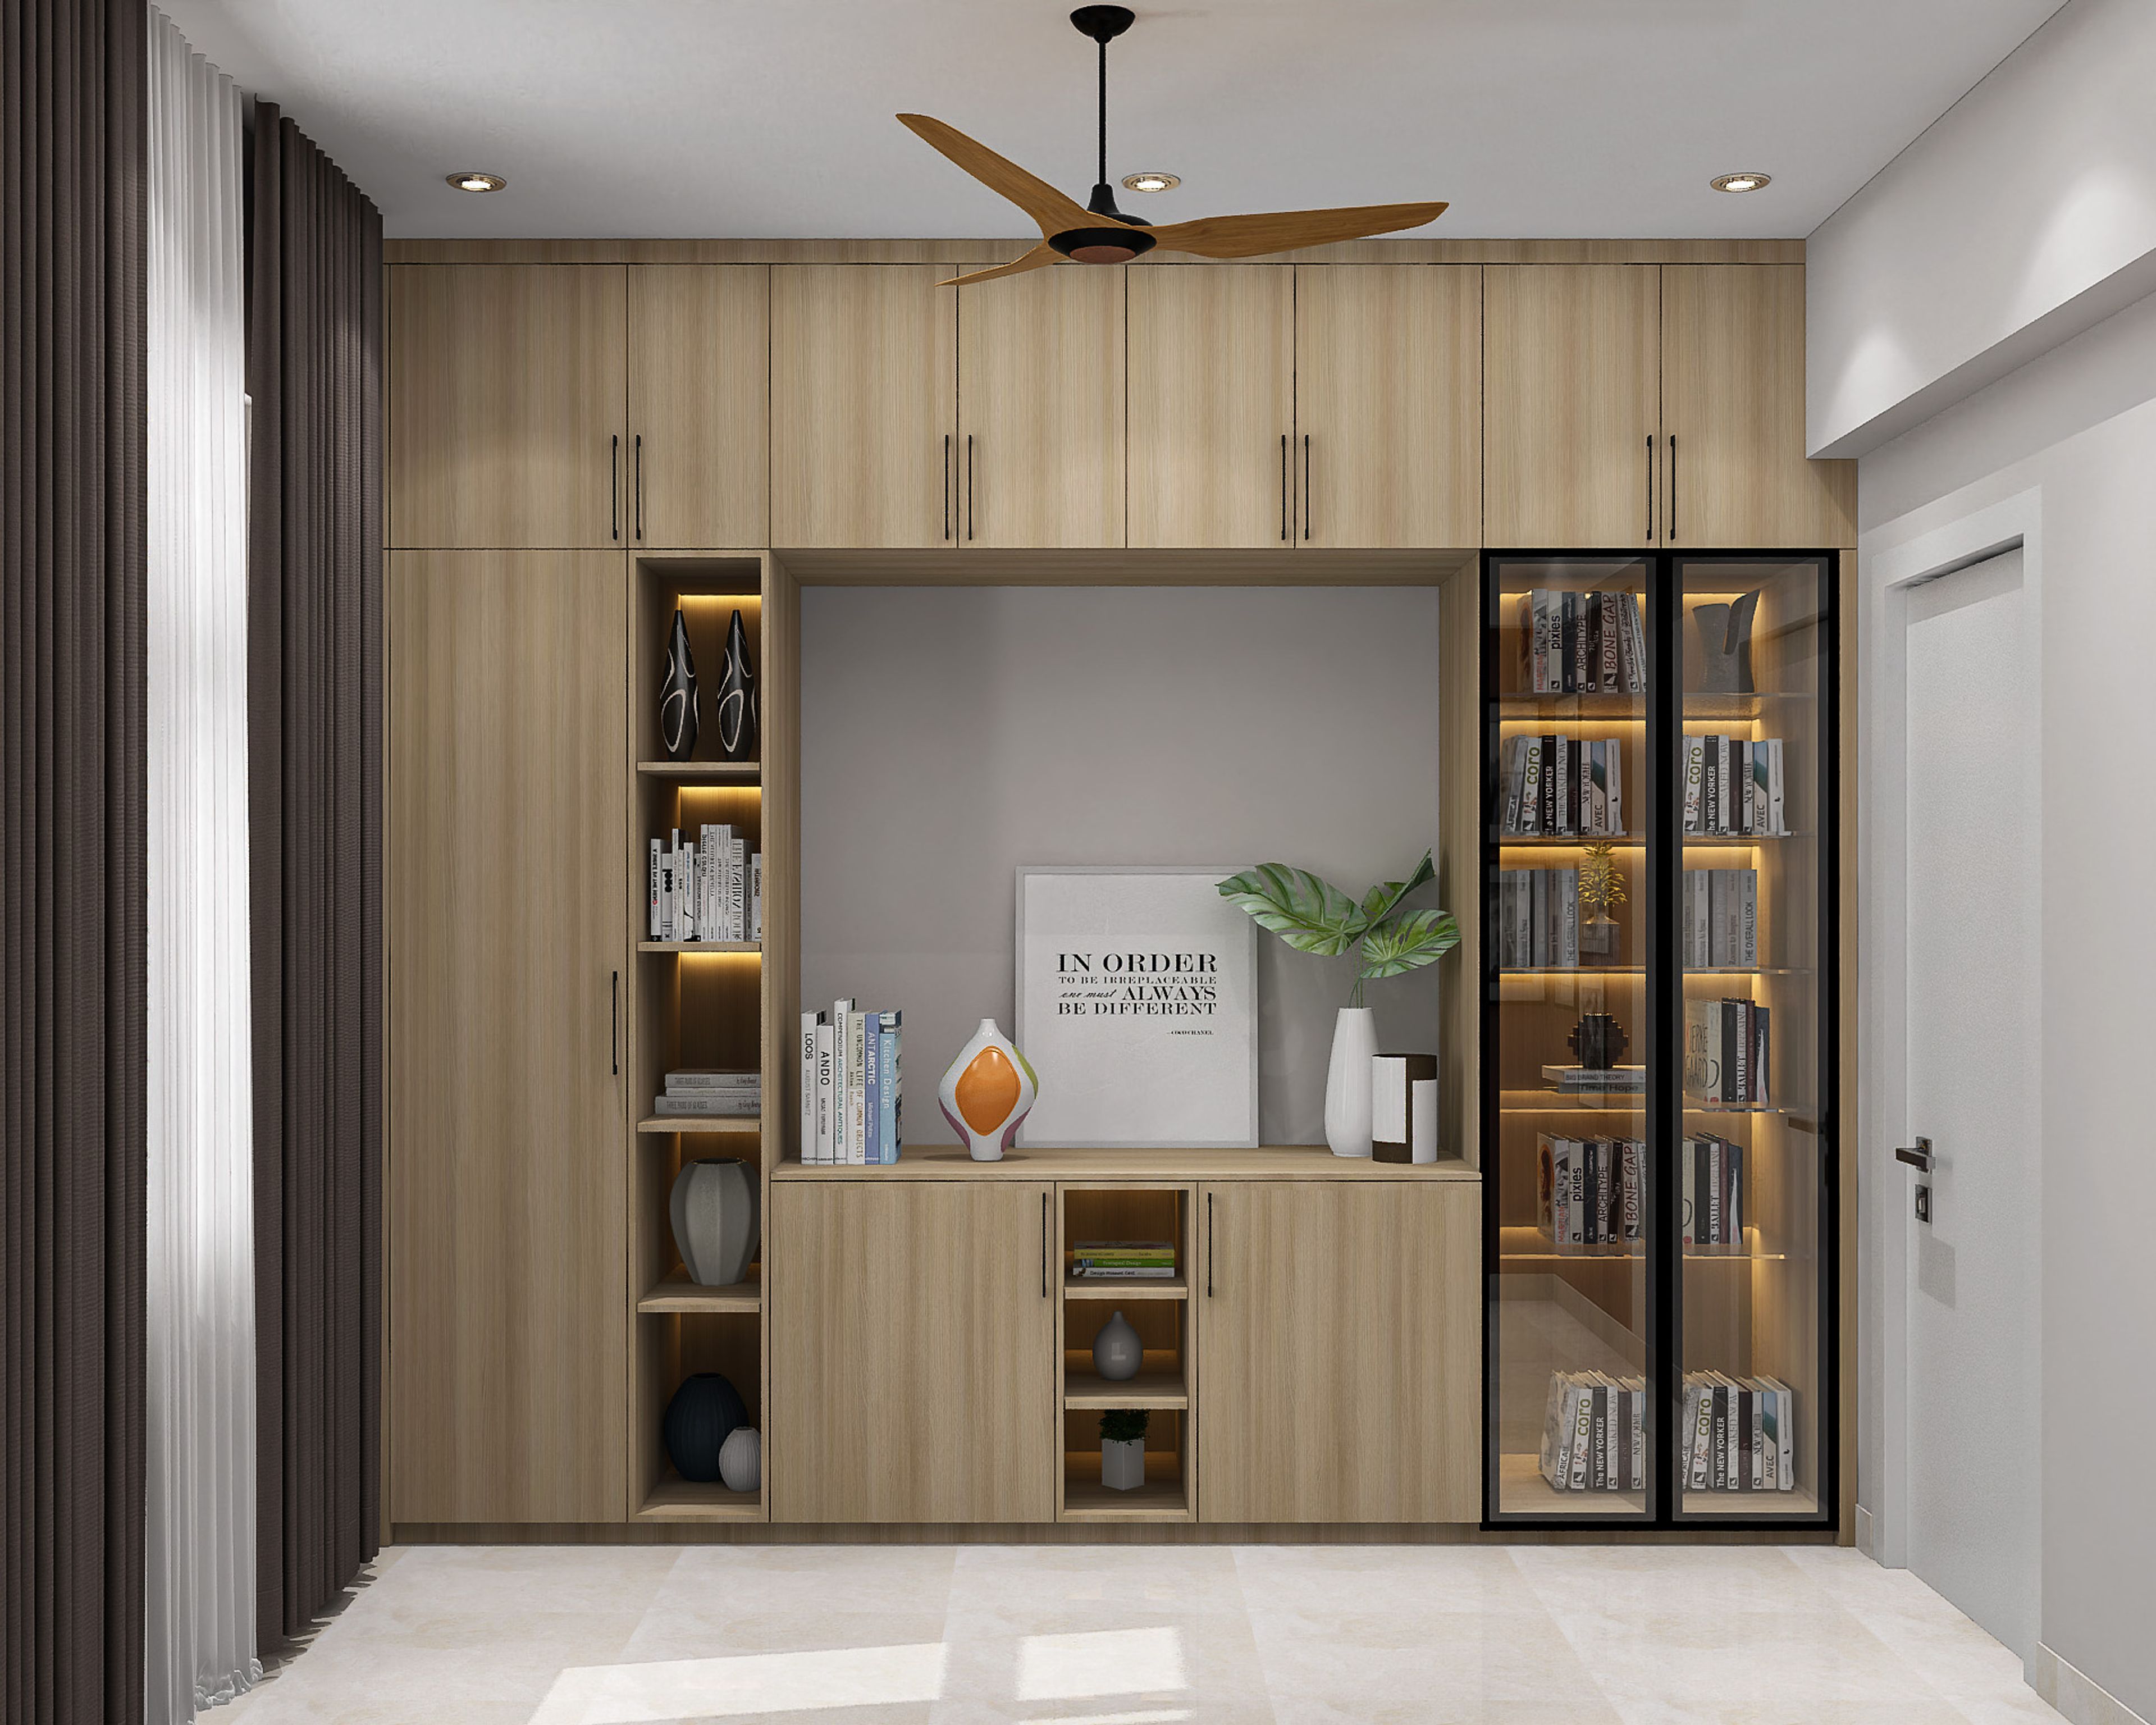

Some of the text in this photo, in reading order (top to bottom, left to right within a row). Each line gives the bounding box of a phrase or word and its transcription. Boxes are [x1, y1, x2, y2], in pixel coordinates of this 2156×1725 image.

[1549, 615, 1563, 650] pixies
[1577, 615, 1586, 671] ARCHITYPE
[1602, 594, 1617, 670] BONE GAP
[1527, 747, 1540, 784] coro
[1557, 743, 1566, 765] NOW
[1688, 747, 1702, 784] coro
[1545, 766, 1554, 798] YORKER
[1557, 768, 1566, 800] NAKED
[1707, 766, 1716, 830] he NEW YORKER
[1545, 801, 1554, 819] NEW
[1056, 953, 1217, 973] IN ORDER
[1057, 1003, 1217, 1015] BE DIFFERENT
[1084, 989, 1117, 998] must
[1122, 986, 1216, 1001] ALWAYS
[820, 1051, 830, 1085] ANDO
[881, 1039, 892, 1110] Kitchen Design
[1570, 1167, 1584, 1202] pixies
[1598, 1166, 1608, 1222] ARCHITYPE
[1624, 1146, 1637, 1221] BONE GAP
[1577, 1399, 1591, 1436] coro
[1698, 1399, 1711, 1436] coro
[1558, 1446, 1570, 1479] AFRICAN
[1766, 1455, 1774, 1478] AVEC
